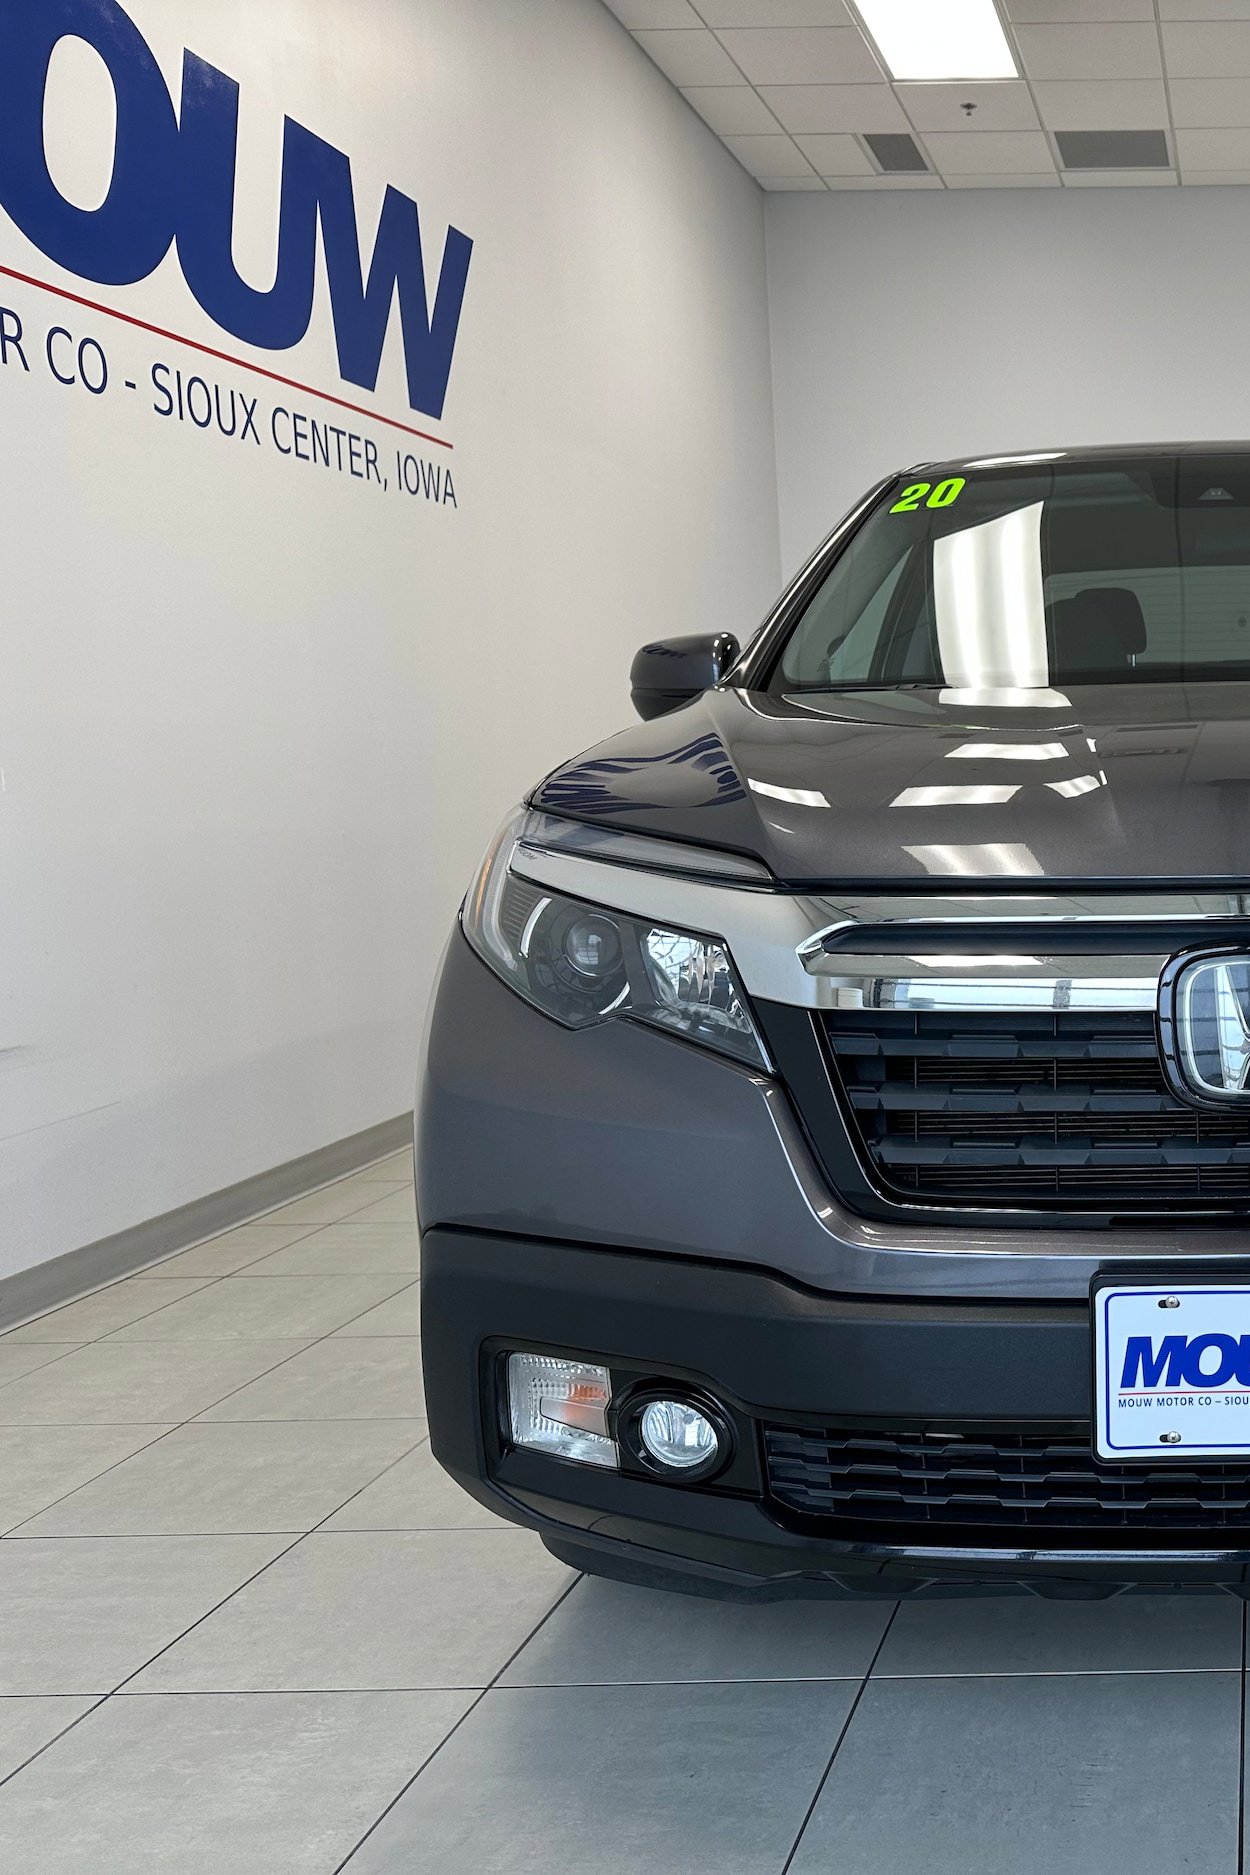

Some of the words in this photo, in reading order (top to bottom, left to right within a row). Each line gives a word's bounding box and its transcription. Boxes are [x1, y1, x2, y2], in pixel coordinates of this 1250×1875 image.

[46, 326, 108, 395] CO
[151, 362, 260, 446] SIOUX
[271, 406, 389, 492] CENTER,
[397, 450, 457, 508] IOWA
[889, 478, 965, 513] 20
[1118, 1398, 1152, 1408] MOUW
[1156, 1397, 1194, 1407] MOTOR
[1198, 1396, 1212, 1406] CO
